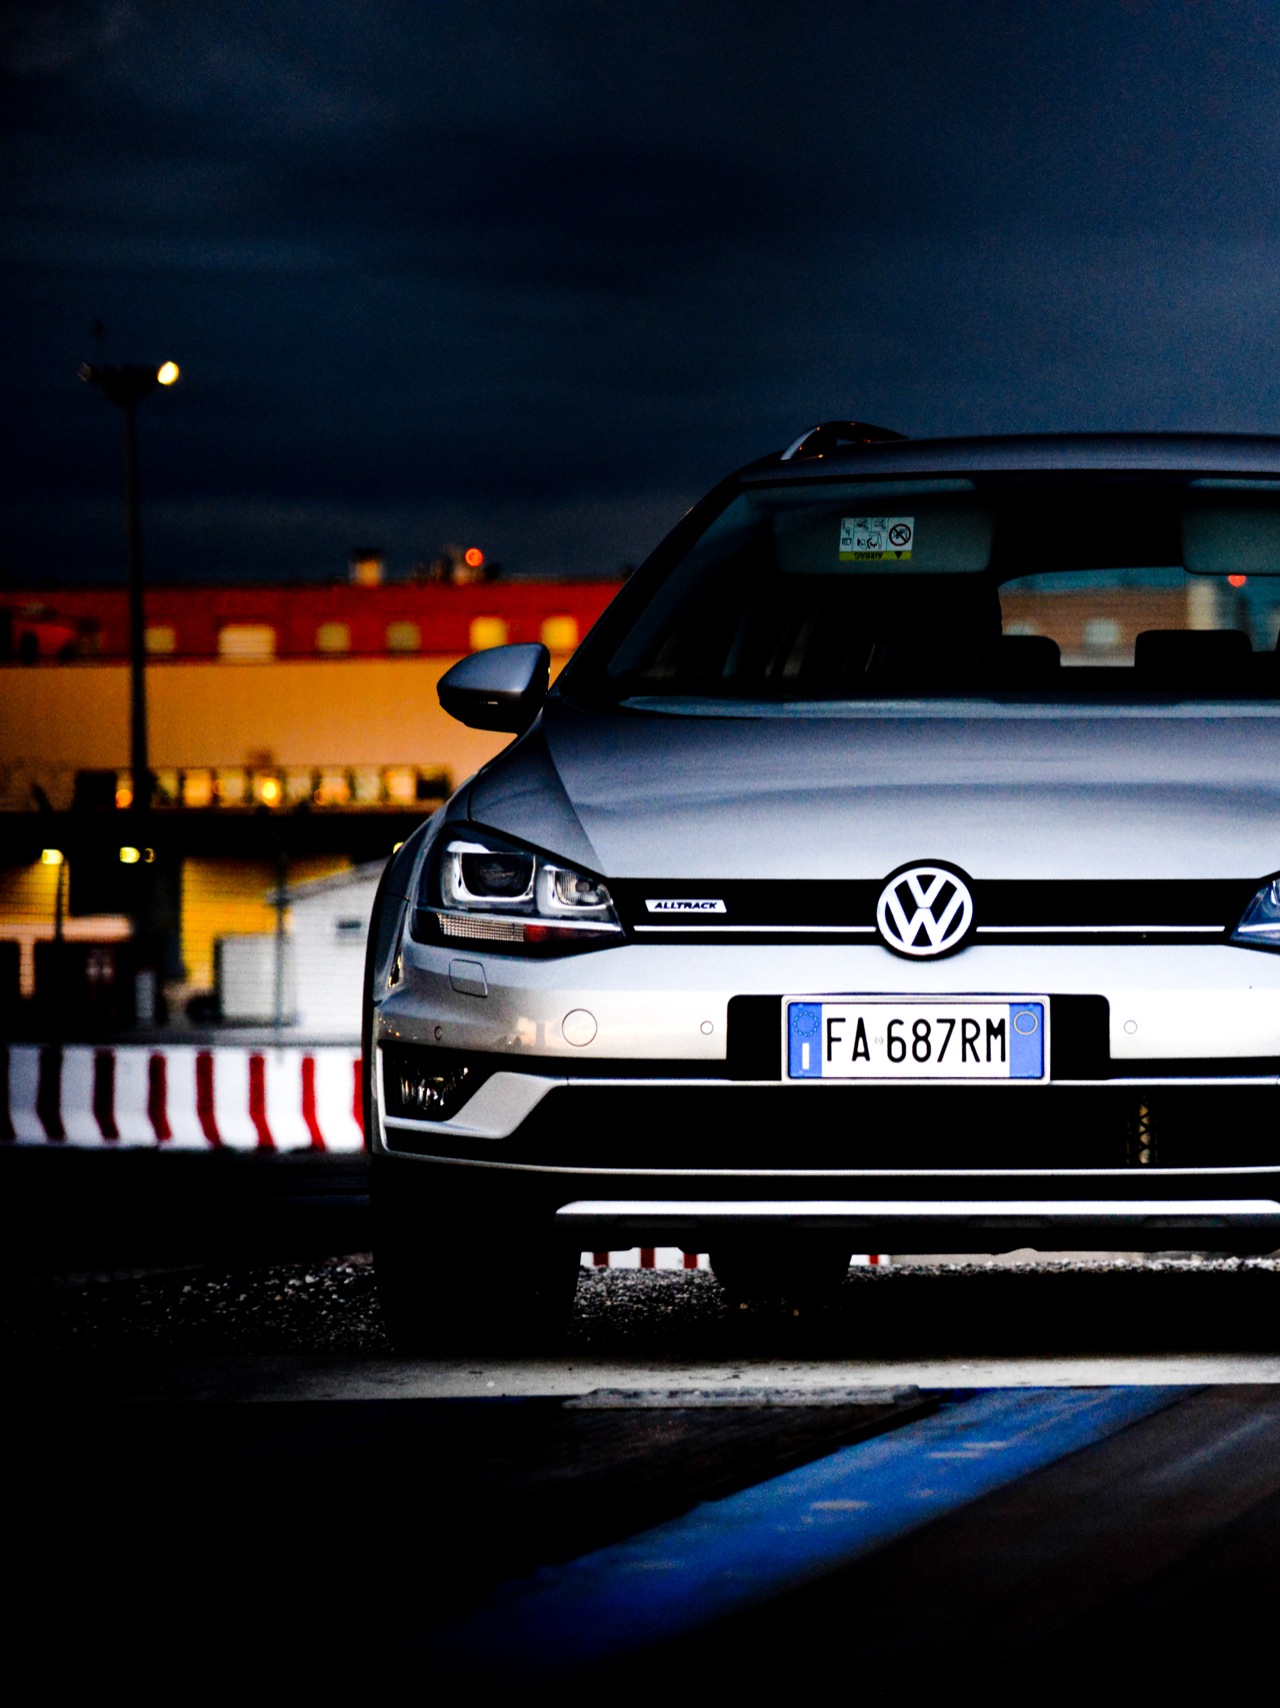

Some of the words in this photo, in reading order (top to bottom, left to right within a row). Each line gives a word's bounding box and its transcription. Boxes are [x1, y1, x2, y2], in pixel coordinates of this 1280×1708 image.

[854, 551, 884, 560] AIRBAG
[654, 901, 717, 910] ALLTRACK
[826, 1017, 871, 1062] FA
[886, 1018, 1006, 1063] 687RM
